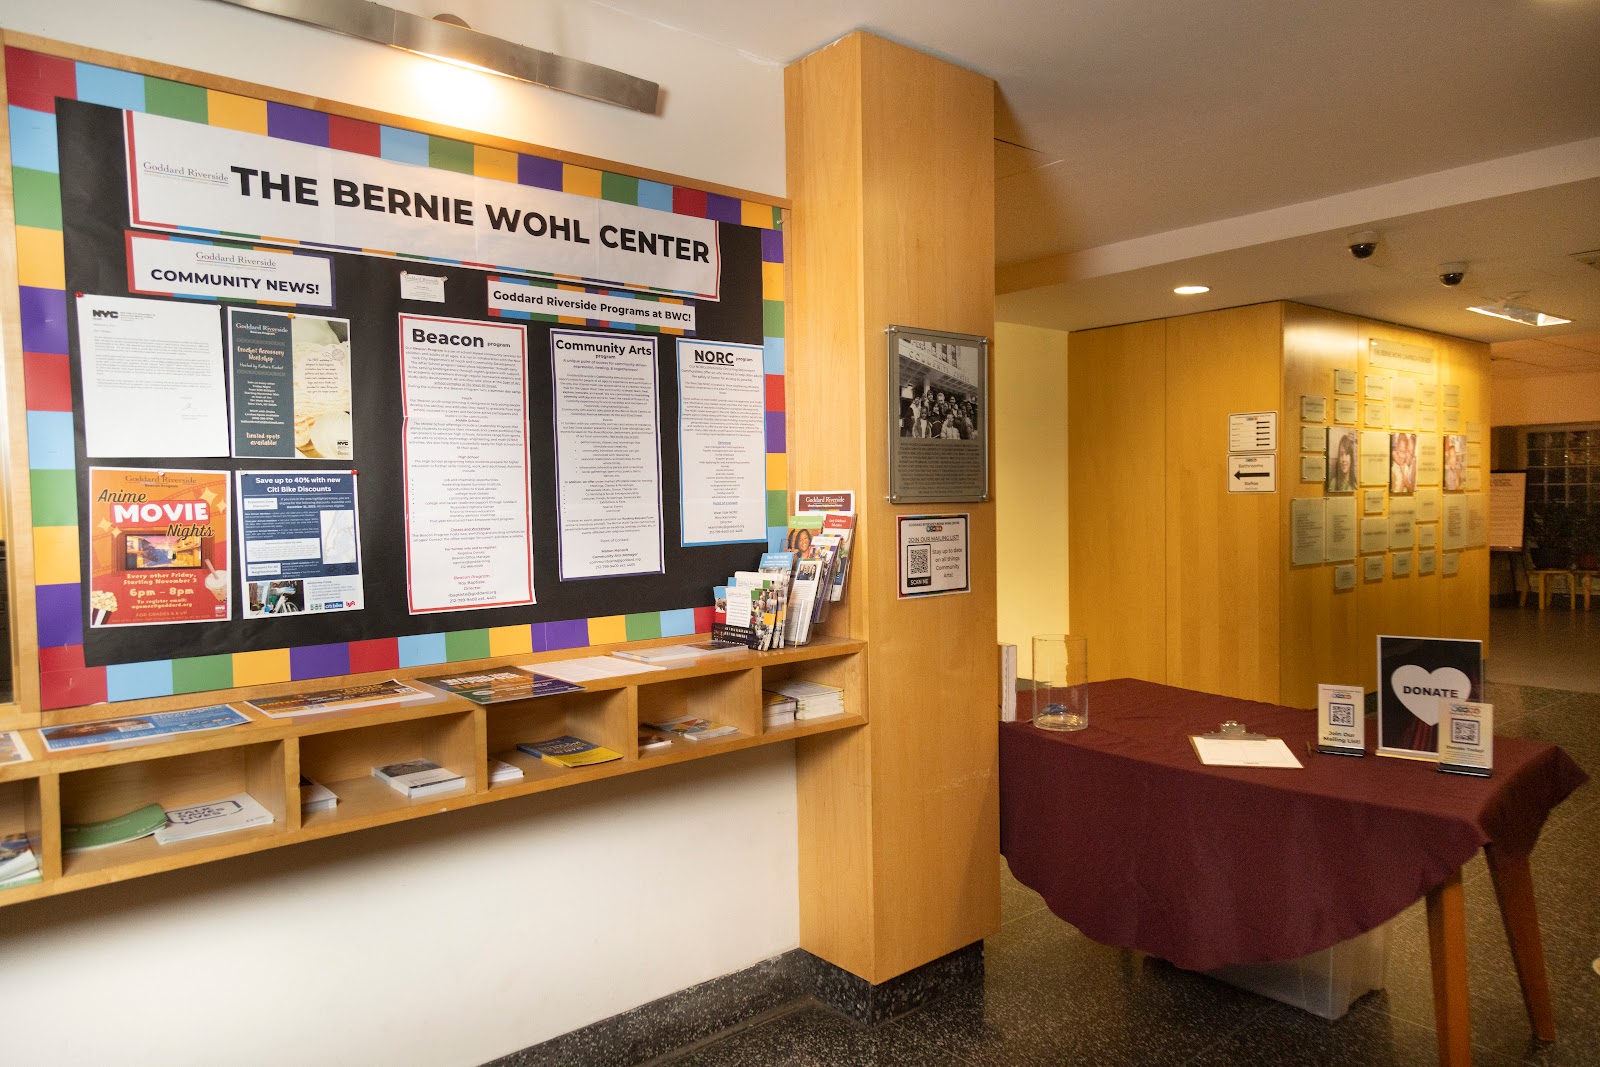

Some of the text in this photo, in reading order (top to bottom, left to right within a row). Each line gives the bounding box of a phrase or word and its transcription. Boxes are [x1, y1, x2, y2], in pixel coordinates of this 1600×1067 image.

[143, 161, 229, 182] Goddard Riverside
[230, 165, 710, 264] THE BERNIE WOHL CENTER
[196, 251, 276, 267] Goddard Riverside
[150, 269, 320, 295] COMMUNITY NEWS!
[494, 290, 691, 322] Goddard Riverside Programs at BWC!
[93, 310, 119, 318] NYC
[236, 323, 289, 333] Goddard Riverside
[412, 328, 484, 348] Beacon
[556, 340, 652, 355] Community Arts
[694, 350, 734, 364] NORC
[125, 475, 197, 484] Goddard Riverside
[97, 488, 148, 503] Anime
[114, 502, 209, 523] MOVIE
[166, 524, 215, 540] Nights
[129, 588, 156, 598] 6pm
[169, 587, 195, 596] 8pm
[1403, 686, 1459, 699] DONATE
[1323, 736, 1346, 744] Mailing
[174, 806, 211, 815] TALK
[177, 808, 225, 818] SAVES
[180, 811, 222, 821] LIVES
